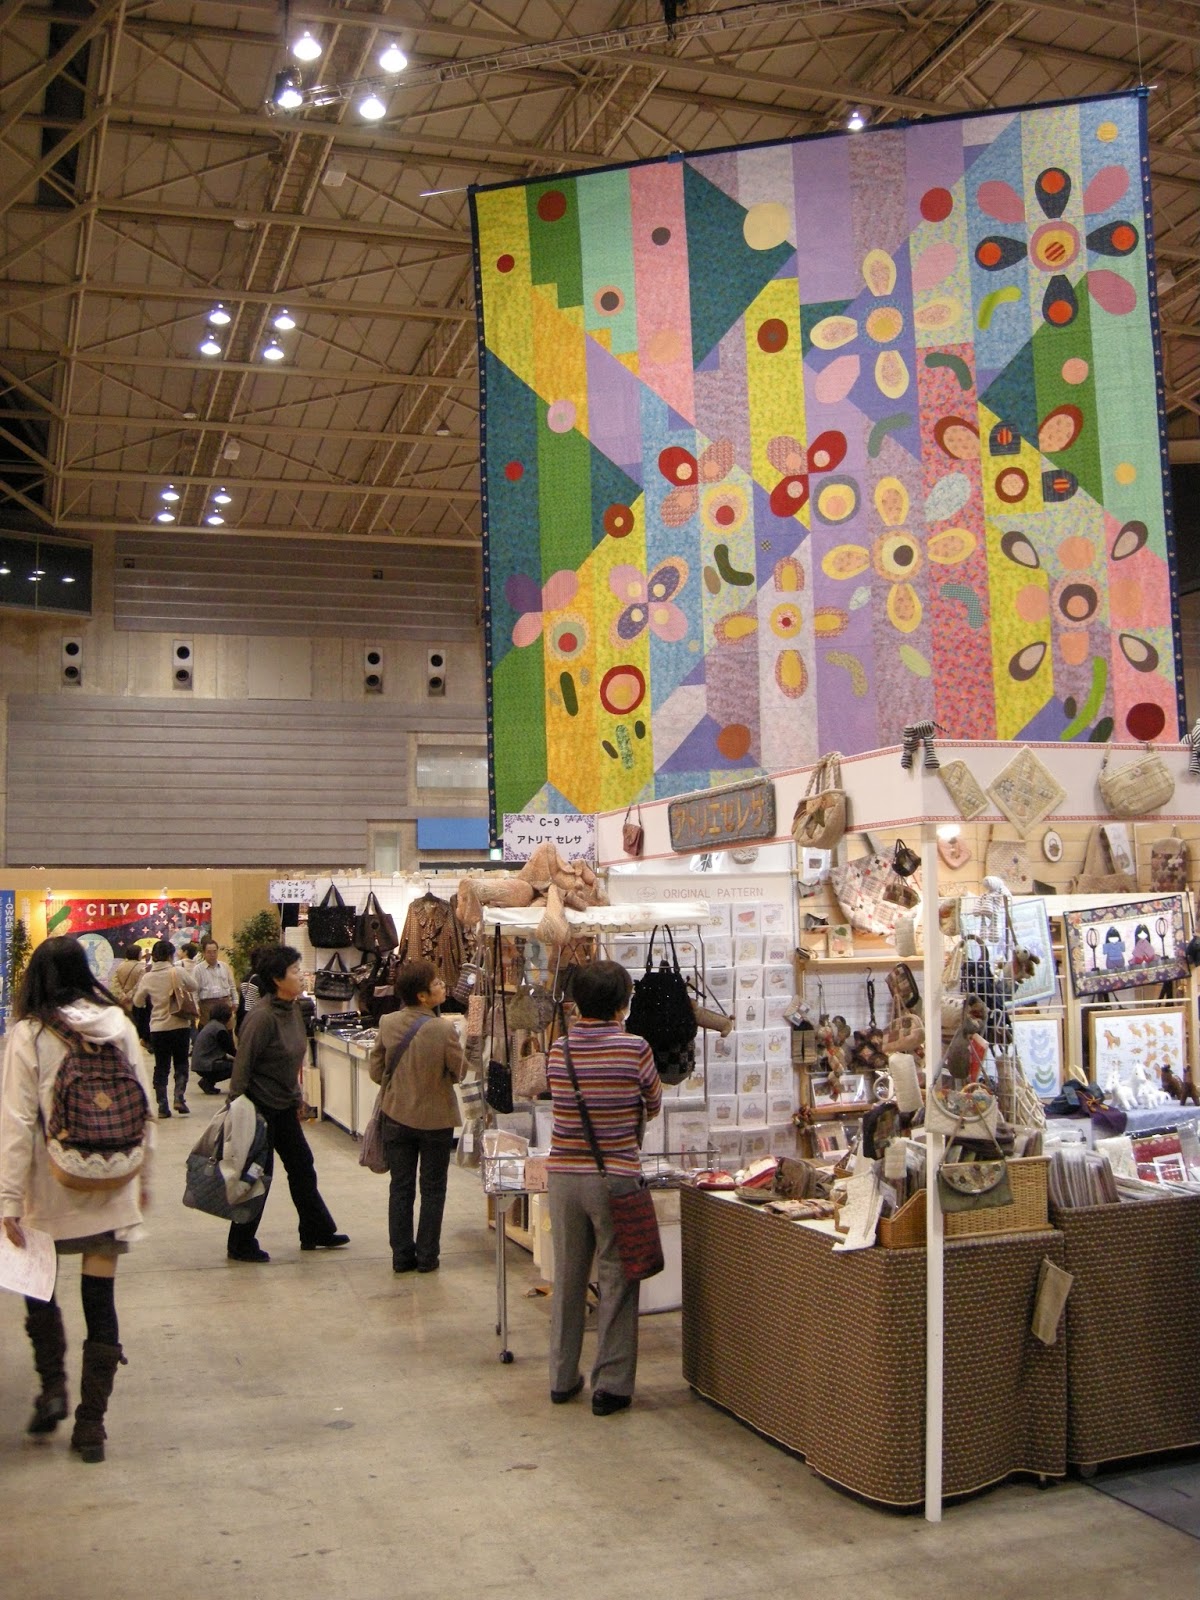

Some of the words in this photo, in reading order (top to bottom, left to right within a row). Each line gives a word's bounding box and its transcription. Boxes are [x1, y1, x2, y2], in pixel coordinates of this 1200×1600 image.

[671, 791, 764, 840] アトリエセレサ
[539, 817, 560, 827] C-9
[556, 835, 582, 845] セレサ
[663, 888, 711, 899] ORIGINAL
[717, 887, 764, 898] PATTERN
[86, 903, 130, 916] CITY
[136, 902, 159, 916] OF
[178, 901, 211, 914] SAP
